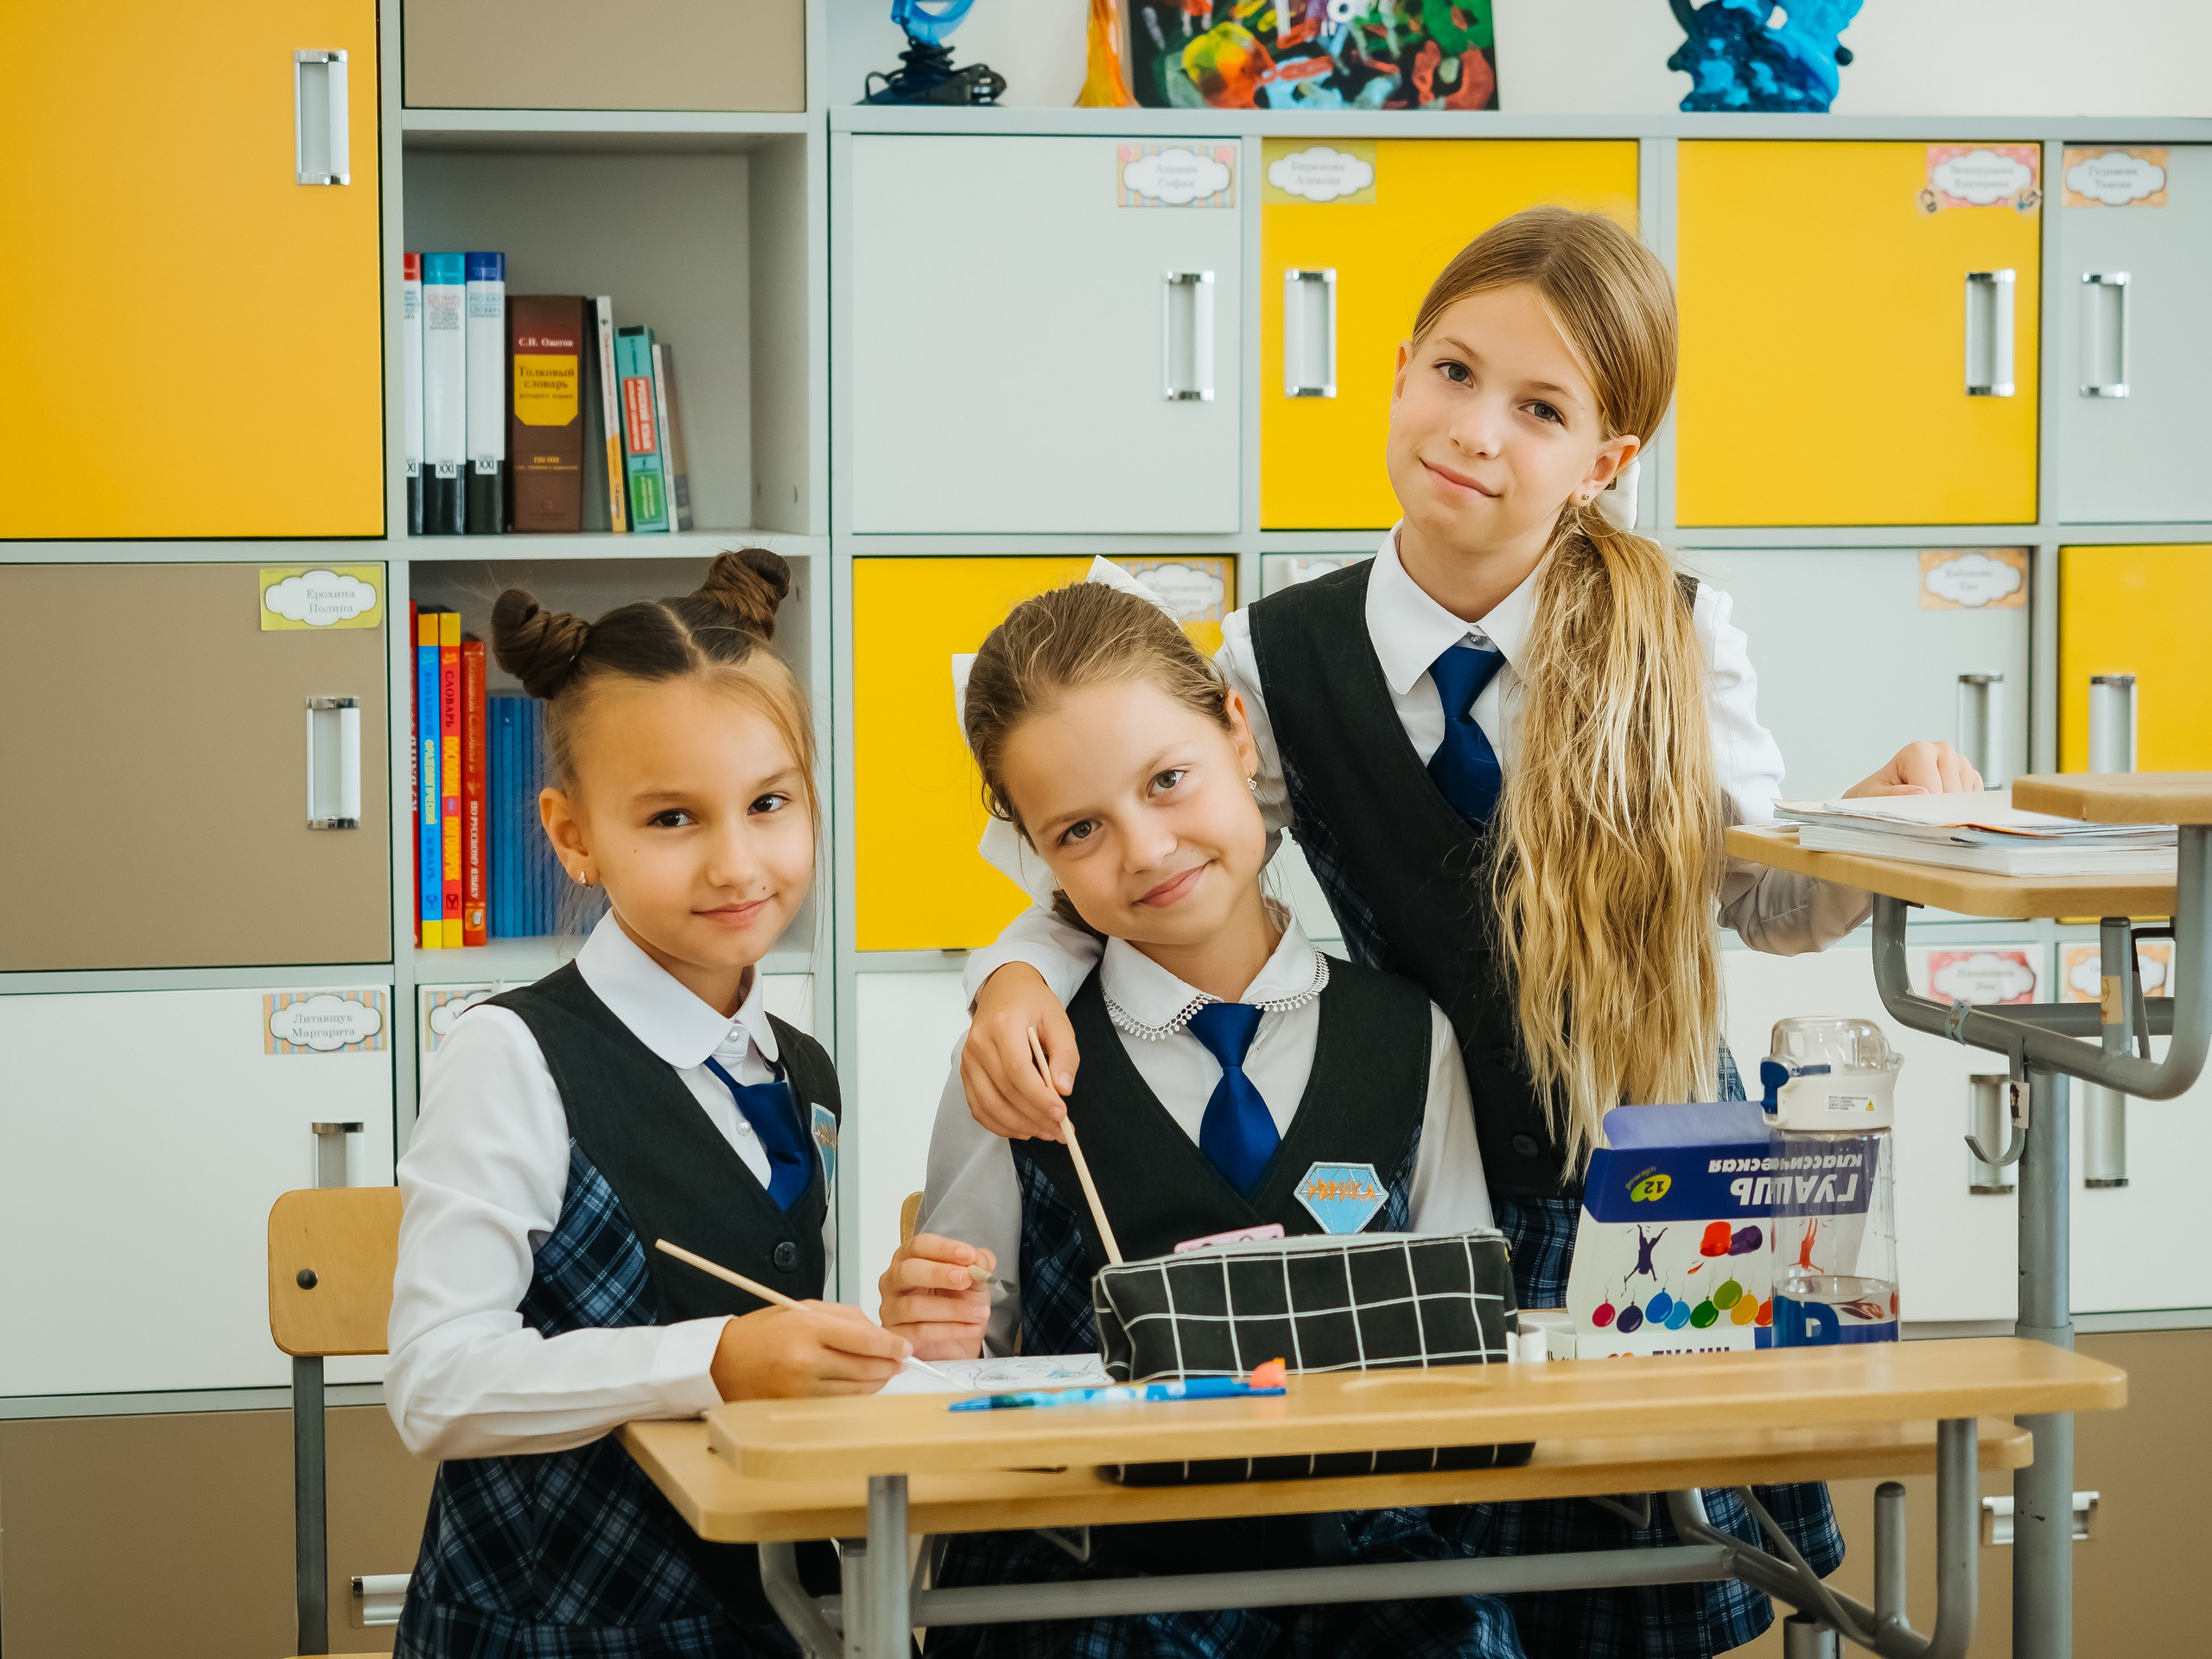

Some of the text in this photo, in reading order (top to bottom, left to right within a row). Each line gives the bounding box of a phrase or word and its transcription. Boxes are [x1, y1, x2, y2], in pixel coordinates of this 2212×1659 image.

[518, 366, 574, 377] Толковый
[524, 380, 568, 391] словарь
[438, 464, 454, 474] XXI
[478, 460, 494, 469] XXI
[307, 589, 355, 600] Ерохина
[309, 604, 353, 613] Полина
[445, 671, 454, 728] СЛОВАРЬ
[471, 801, 478, 815] ПО
[293, 1014, 353, 1024] Литавщук
[292, 1028, 355, 1039] Маргарита
[1708, 1154, 1863, 1173] классическая
[1306, 1178, 1378, 1203] ЭВРИКА
[1643, 1180, 1664, 1194] 12
[1730, 1173, 1859, 1206] ГУАШЬ
